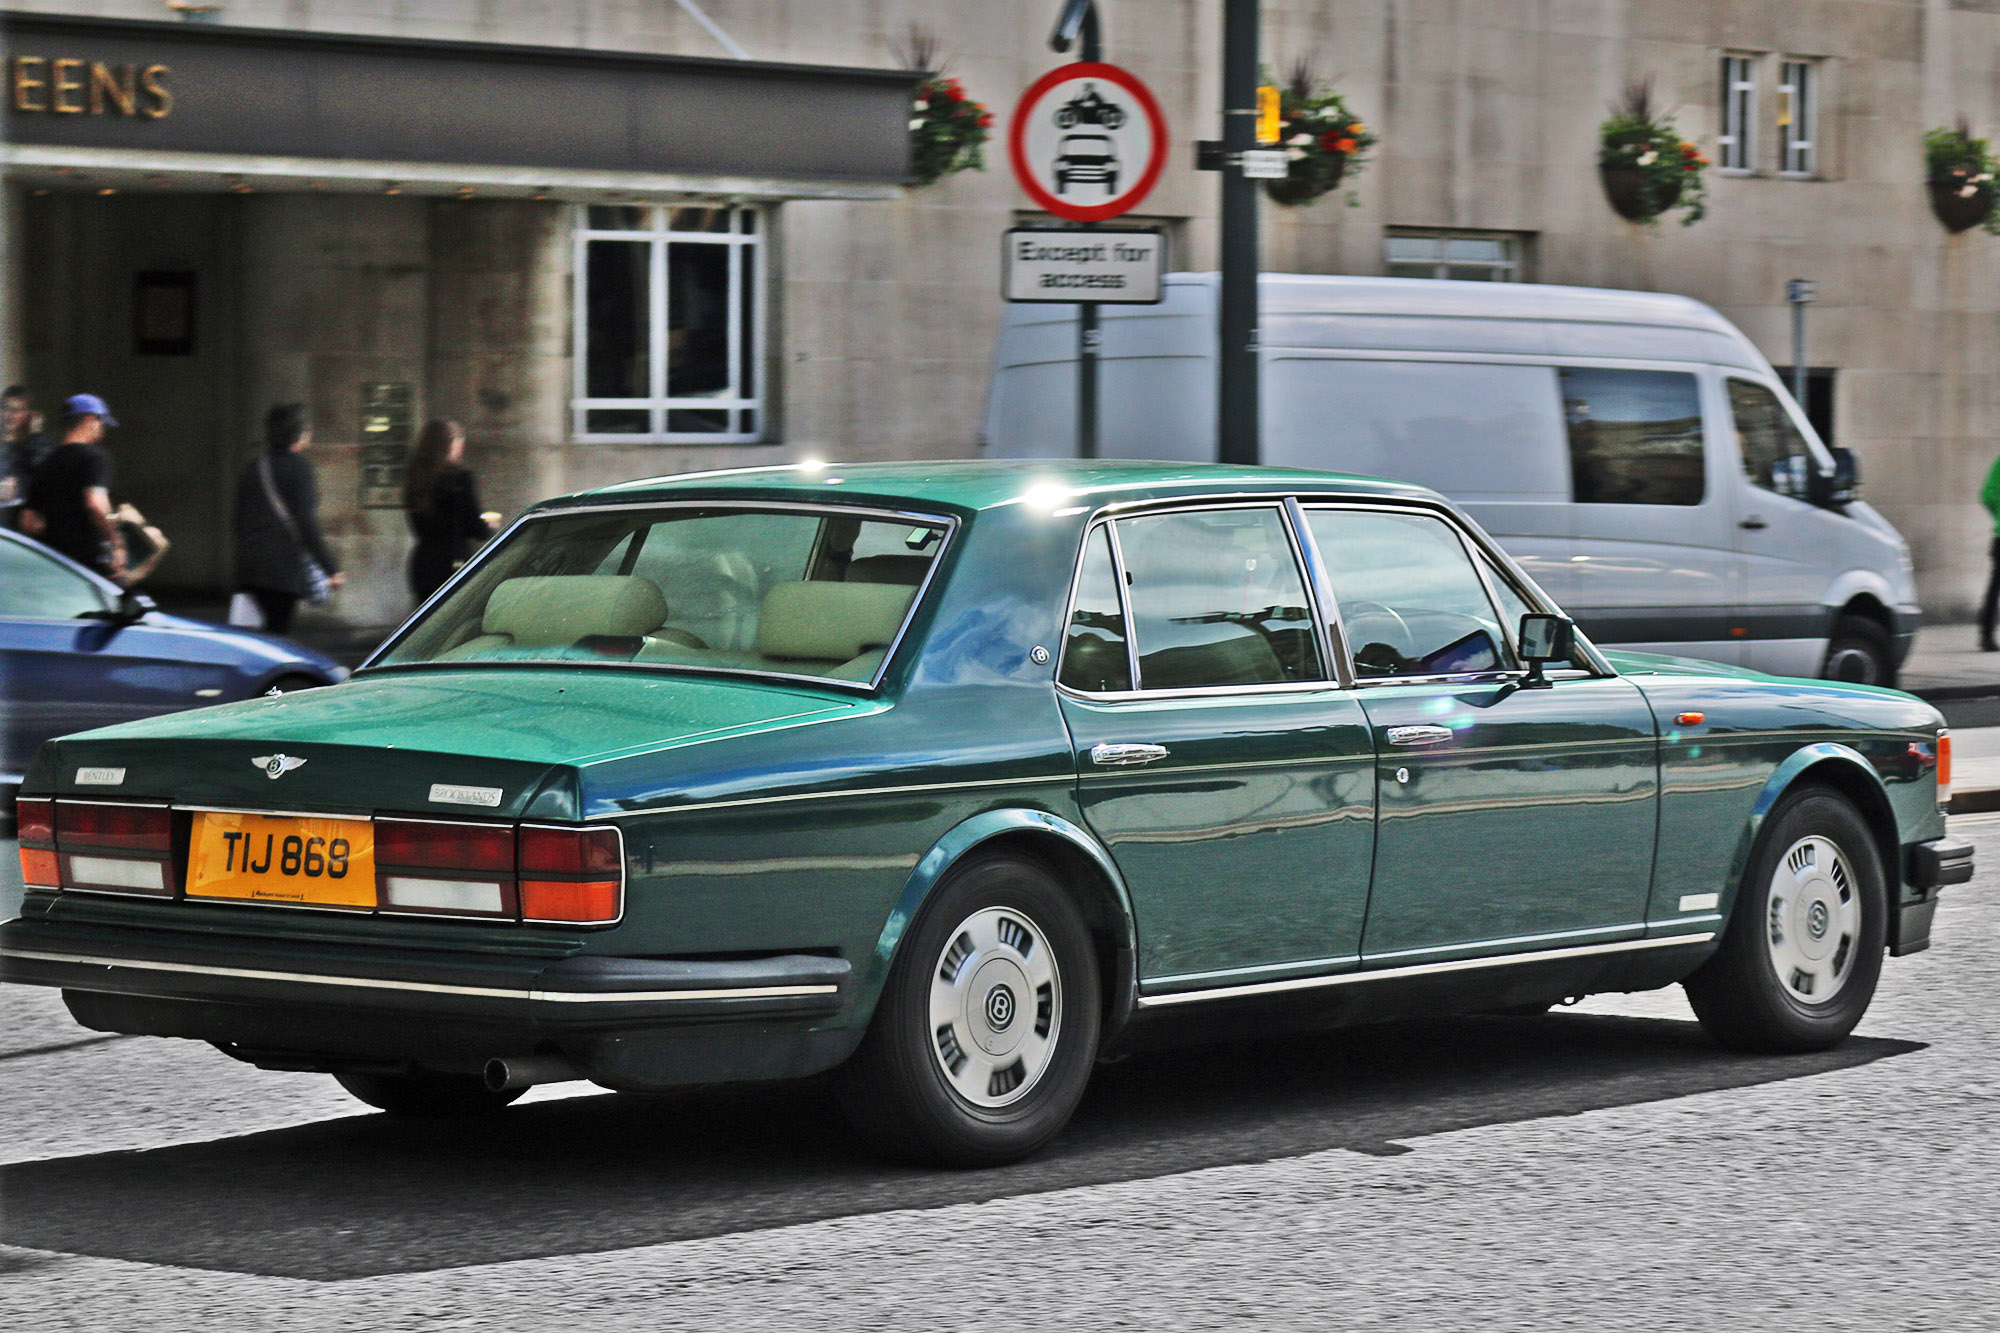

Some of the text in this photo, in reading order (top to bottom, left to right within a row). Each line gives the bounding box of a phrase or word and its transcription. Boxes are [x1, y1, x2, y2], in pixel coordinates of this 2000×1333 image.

[1018, 241, 1152, 264] Except for
[1040, 273, 1127, 288] access
[223, 831, 350, 879] TIJ 868
